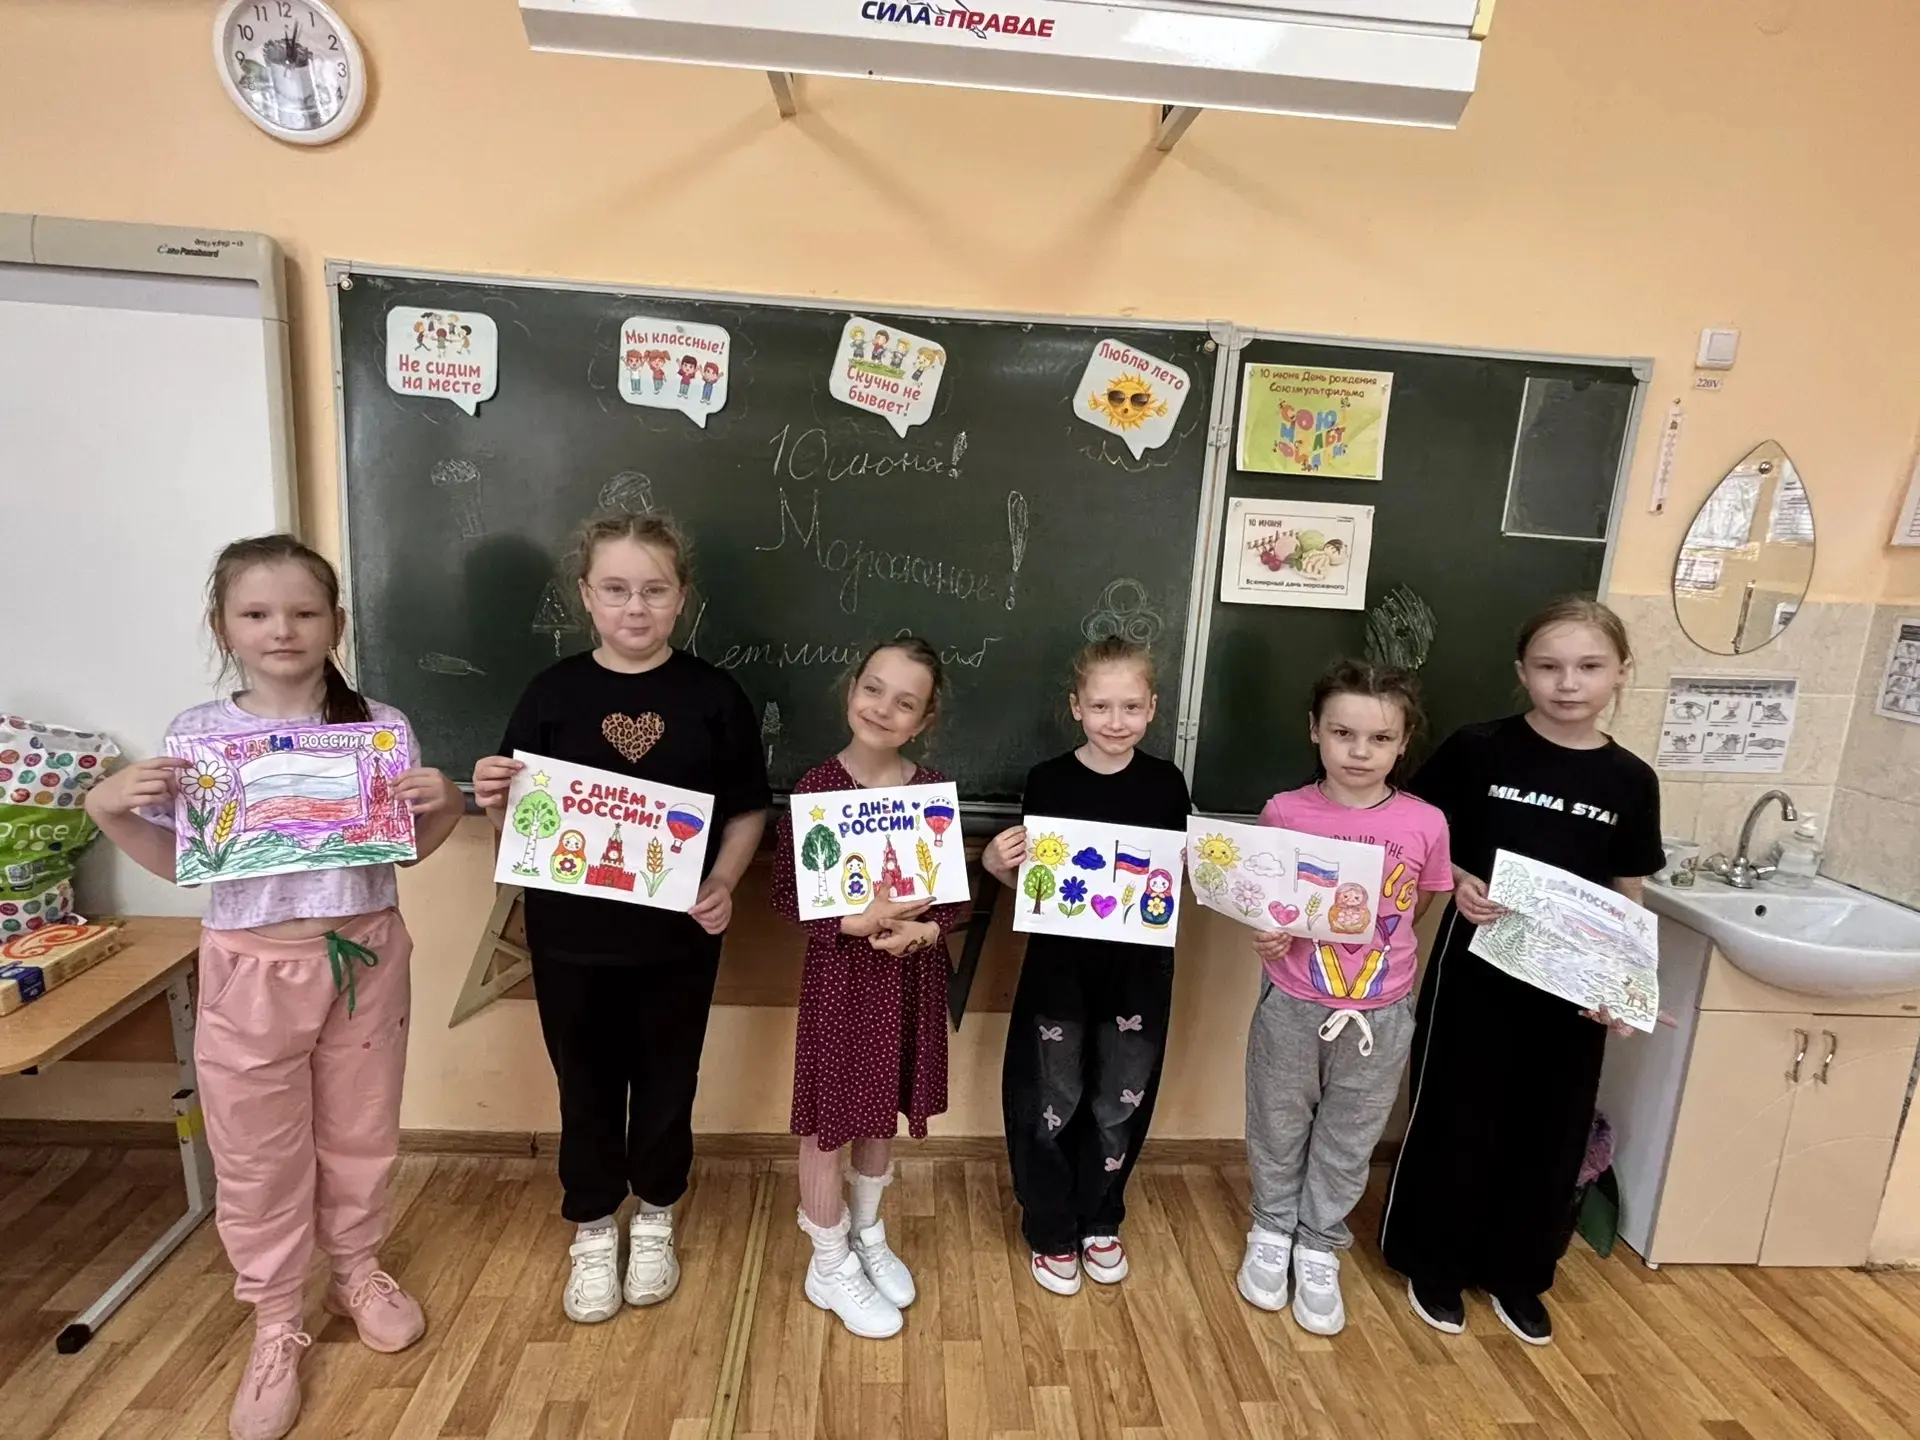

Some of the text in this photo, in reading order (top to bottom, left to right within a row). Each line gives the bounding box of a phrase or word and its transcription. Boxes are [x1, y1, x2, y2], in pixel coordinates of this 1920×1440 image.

[253, 5, 268, 22] 11
[276, 1, 292, 18] 12
[308, 11, 315, 27] 1
[861, 1, 931, 26] СИЛА
[948, 9, 1055, 38] ПРАВДЕ
[237, 24, 254, 41] 10
[328, 34, 339, 51] 2
[235, 50, 245, 66] 9
[337, 62, 347, 78] 3
[625, 329, 725, 355] Мы классные!
[398, 354, 481, 379] Не сидим
[1099, 342, 1184, 390] Люблю лето
[402, 376, 482, 395] на месте
[846, 364, 921, 401] Скучно не
[1260, 368, 1377, 385] 10 июня День рождения
[1696, 378, 1720, 389] 220V
[1269, 382, 1365, 398] Союзмультфильма
[848, 385, 911, 417] бывает!
[769, 424, 828, 480] 10
[1249, 518, 1256, 527] 10
[1246, 578, 1285, 587] Всемирный
[224, 743, 241, 761] С
[298, 734, 366, 750] РОССИИ!
[570, 780, 647, 808] С ДНЁМ
[1488, 784, 1565, 812] MILANA
[562, 795, 662, 830] РОССИИ!
[842, 798, 906, 819] С ДНЁМ
[838, 815, 921, 839] РОССИИ!
[1384, 840, 1404, 860] THE
